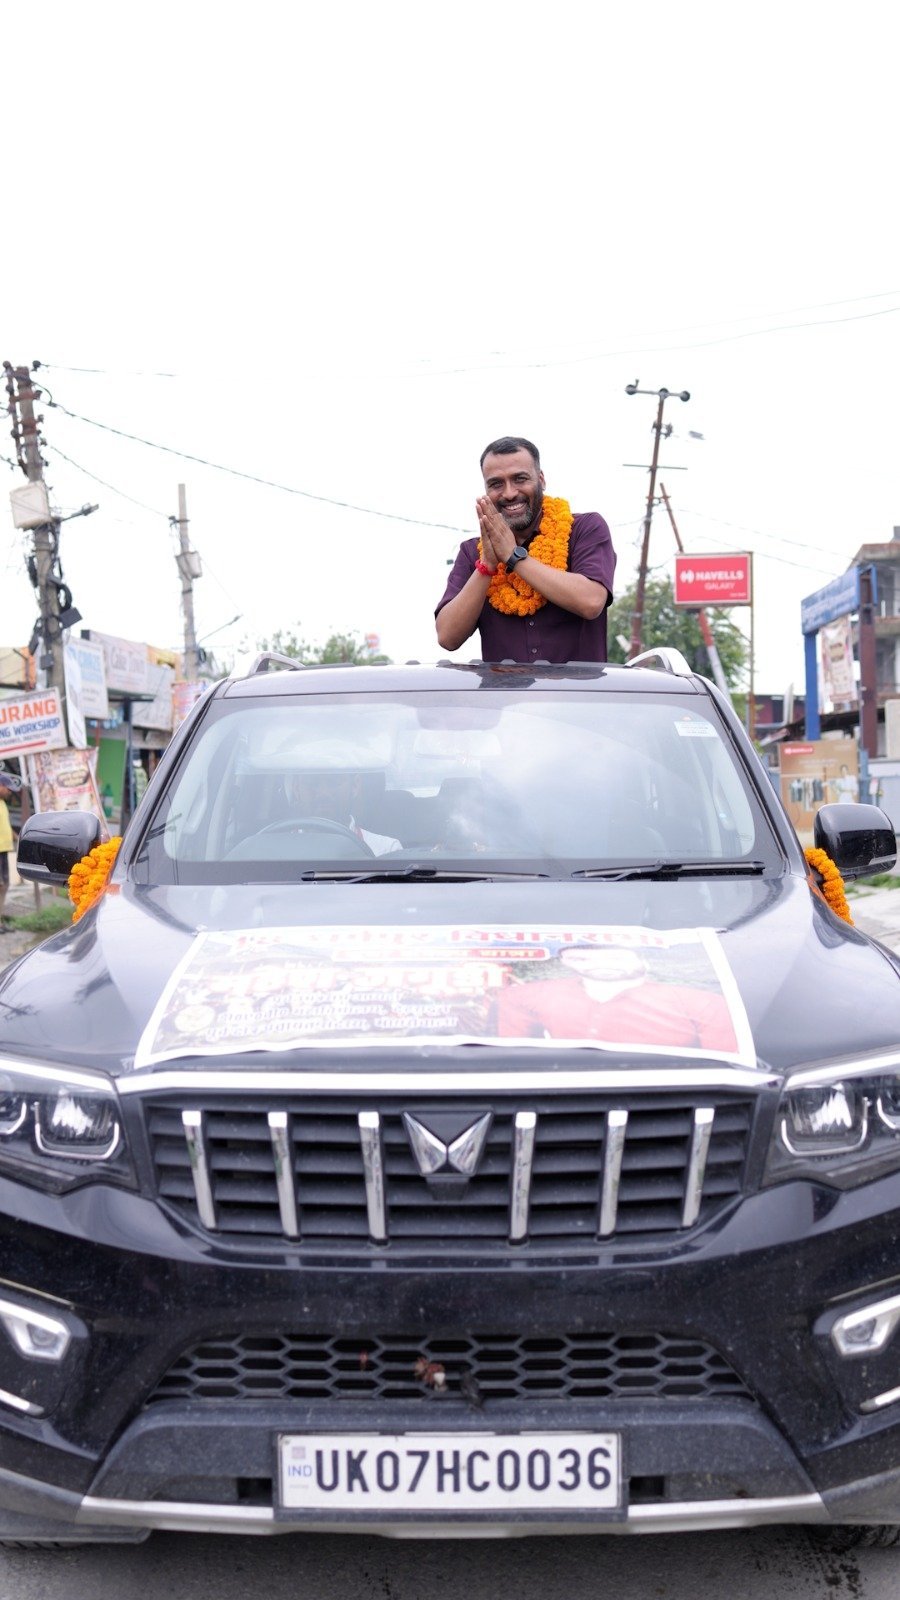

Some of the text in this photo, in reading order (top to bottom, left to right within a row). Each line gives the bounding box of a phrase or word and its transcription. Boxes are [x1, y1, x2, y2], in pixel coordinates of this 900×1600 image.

[696, 570, 744, 581] HAVELLS
[14, 717, 60, 735] WORKSHOP
[288, 1464, 313, 1478] IND
[315, 1447, 612, 1493] UK07HC0036
